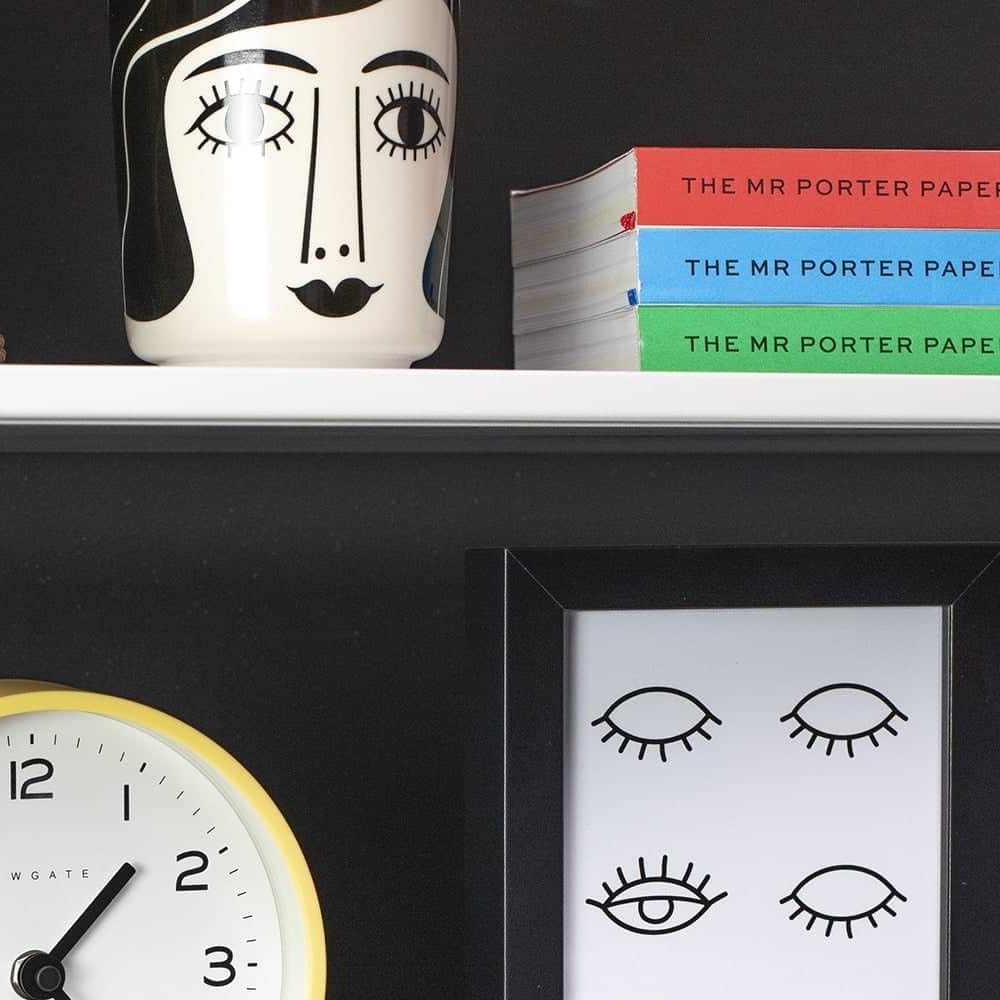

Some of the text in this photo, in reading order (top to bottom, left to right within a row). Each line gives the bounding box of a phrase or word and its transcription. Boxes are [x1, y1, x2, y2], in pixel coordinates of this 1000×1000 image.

[681, 177, 736, 198] THE
[747, 177, 785, 198] MR
[797, 177, 909, 198] PORTER
[684, 259, 1000, 278] THE MR PORTER PAPE
[684, 335, 1000, 354] THE MR PORTER PAPE
[9, 757, 55, 801] 12
[123, 783, 130, 822] 1
[175, 850, 209, 892] 2
[203, 945, 236, 988] 3
